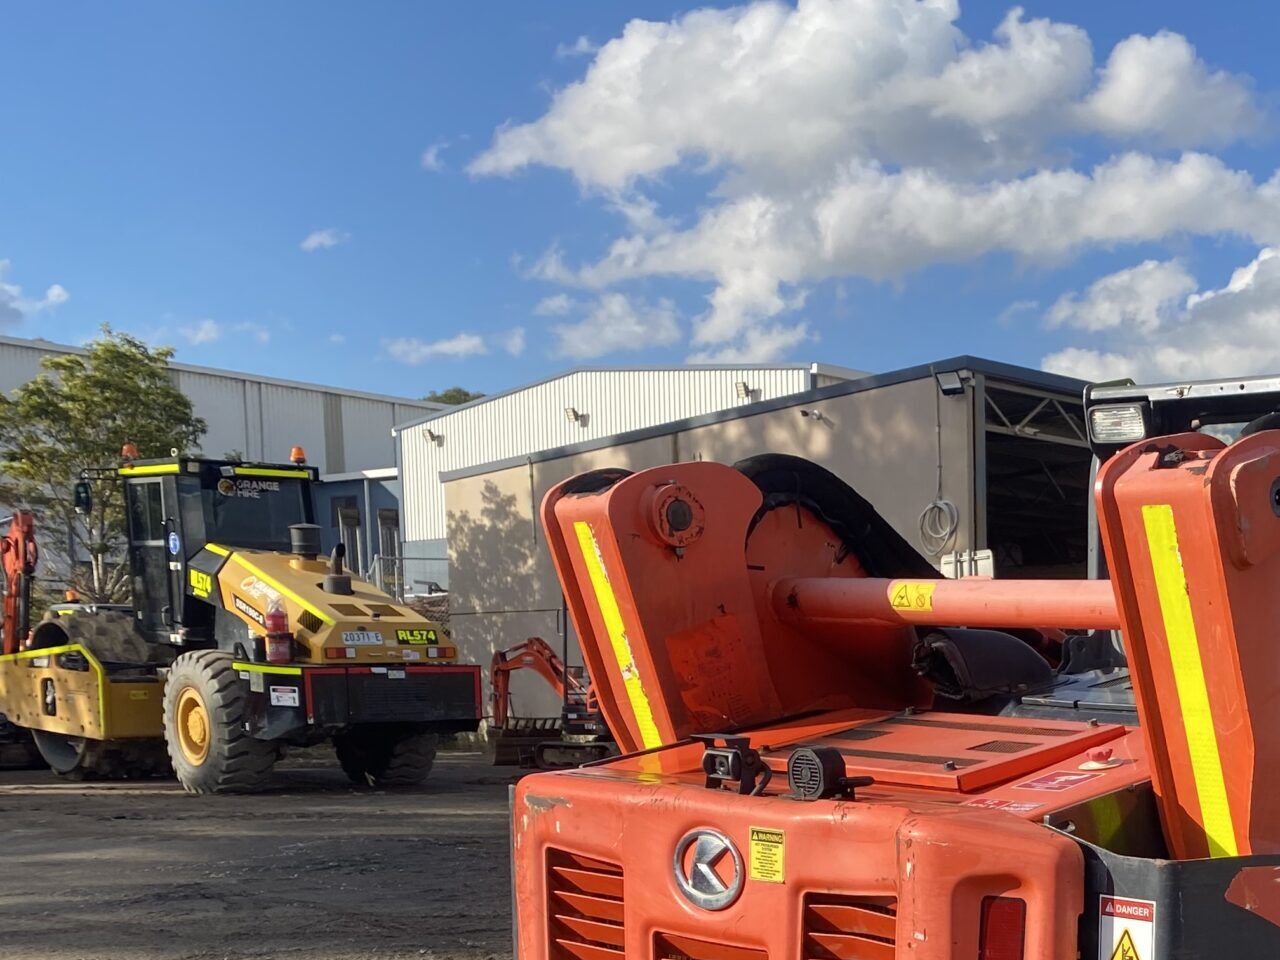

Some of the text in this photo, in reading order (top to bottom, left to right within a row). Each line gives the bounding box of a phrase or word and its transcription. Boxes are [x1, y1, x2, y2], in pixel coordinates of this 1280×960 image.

[236, 480, 280, 491] ORANGE
[236, 488, 260, 498] HIRE
[397, 630, 436, 641] RL574
[758, 832, 783, 844] WARNING
[1115, 904, 1150, 917] DANGER
